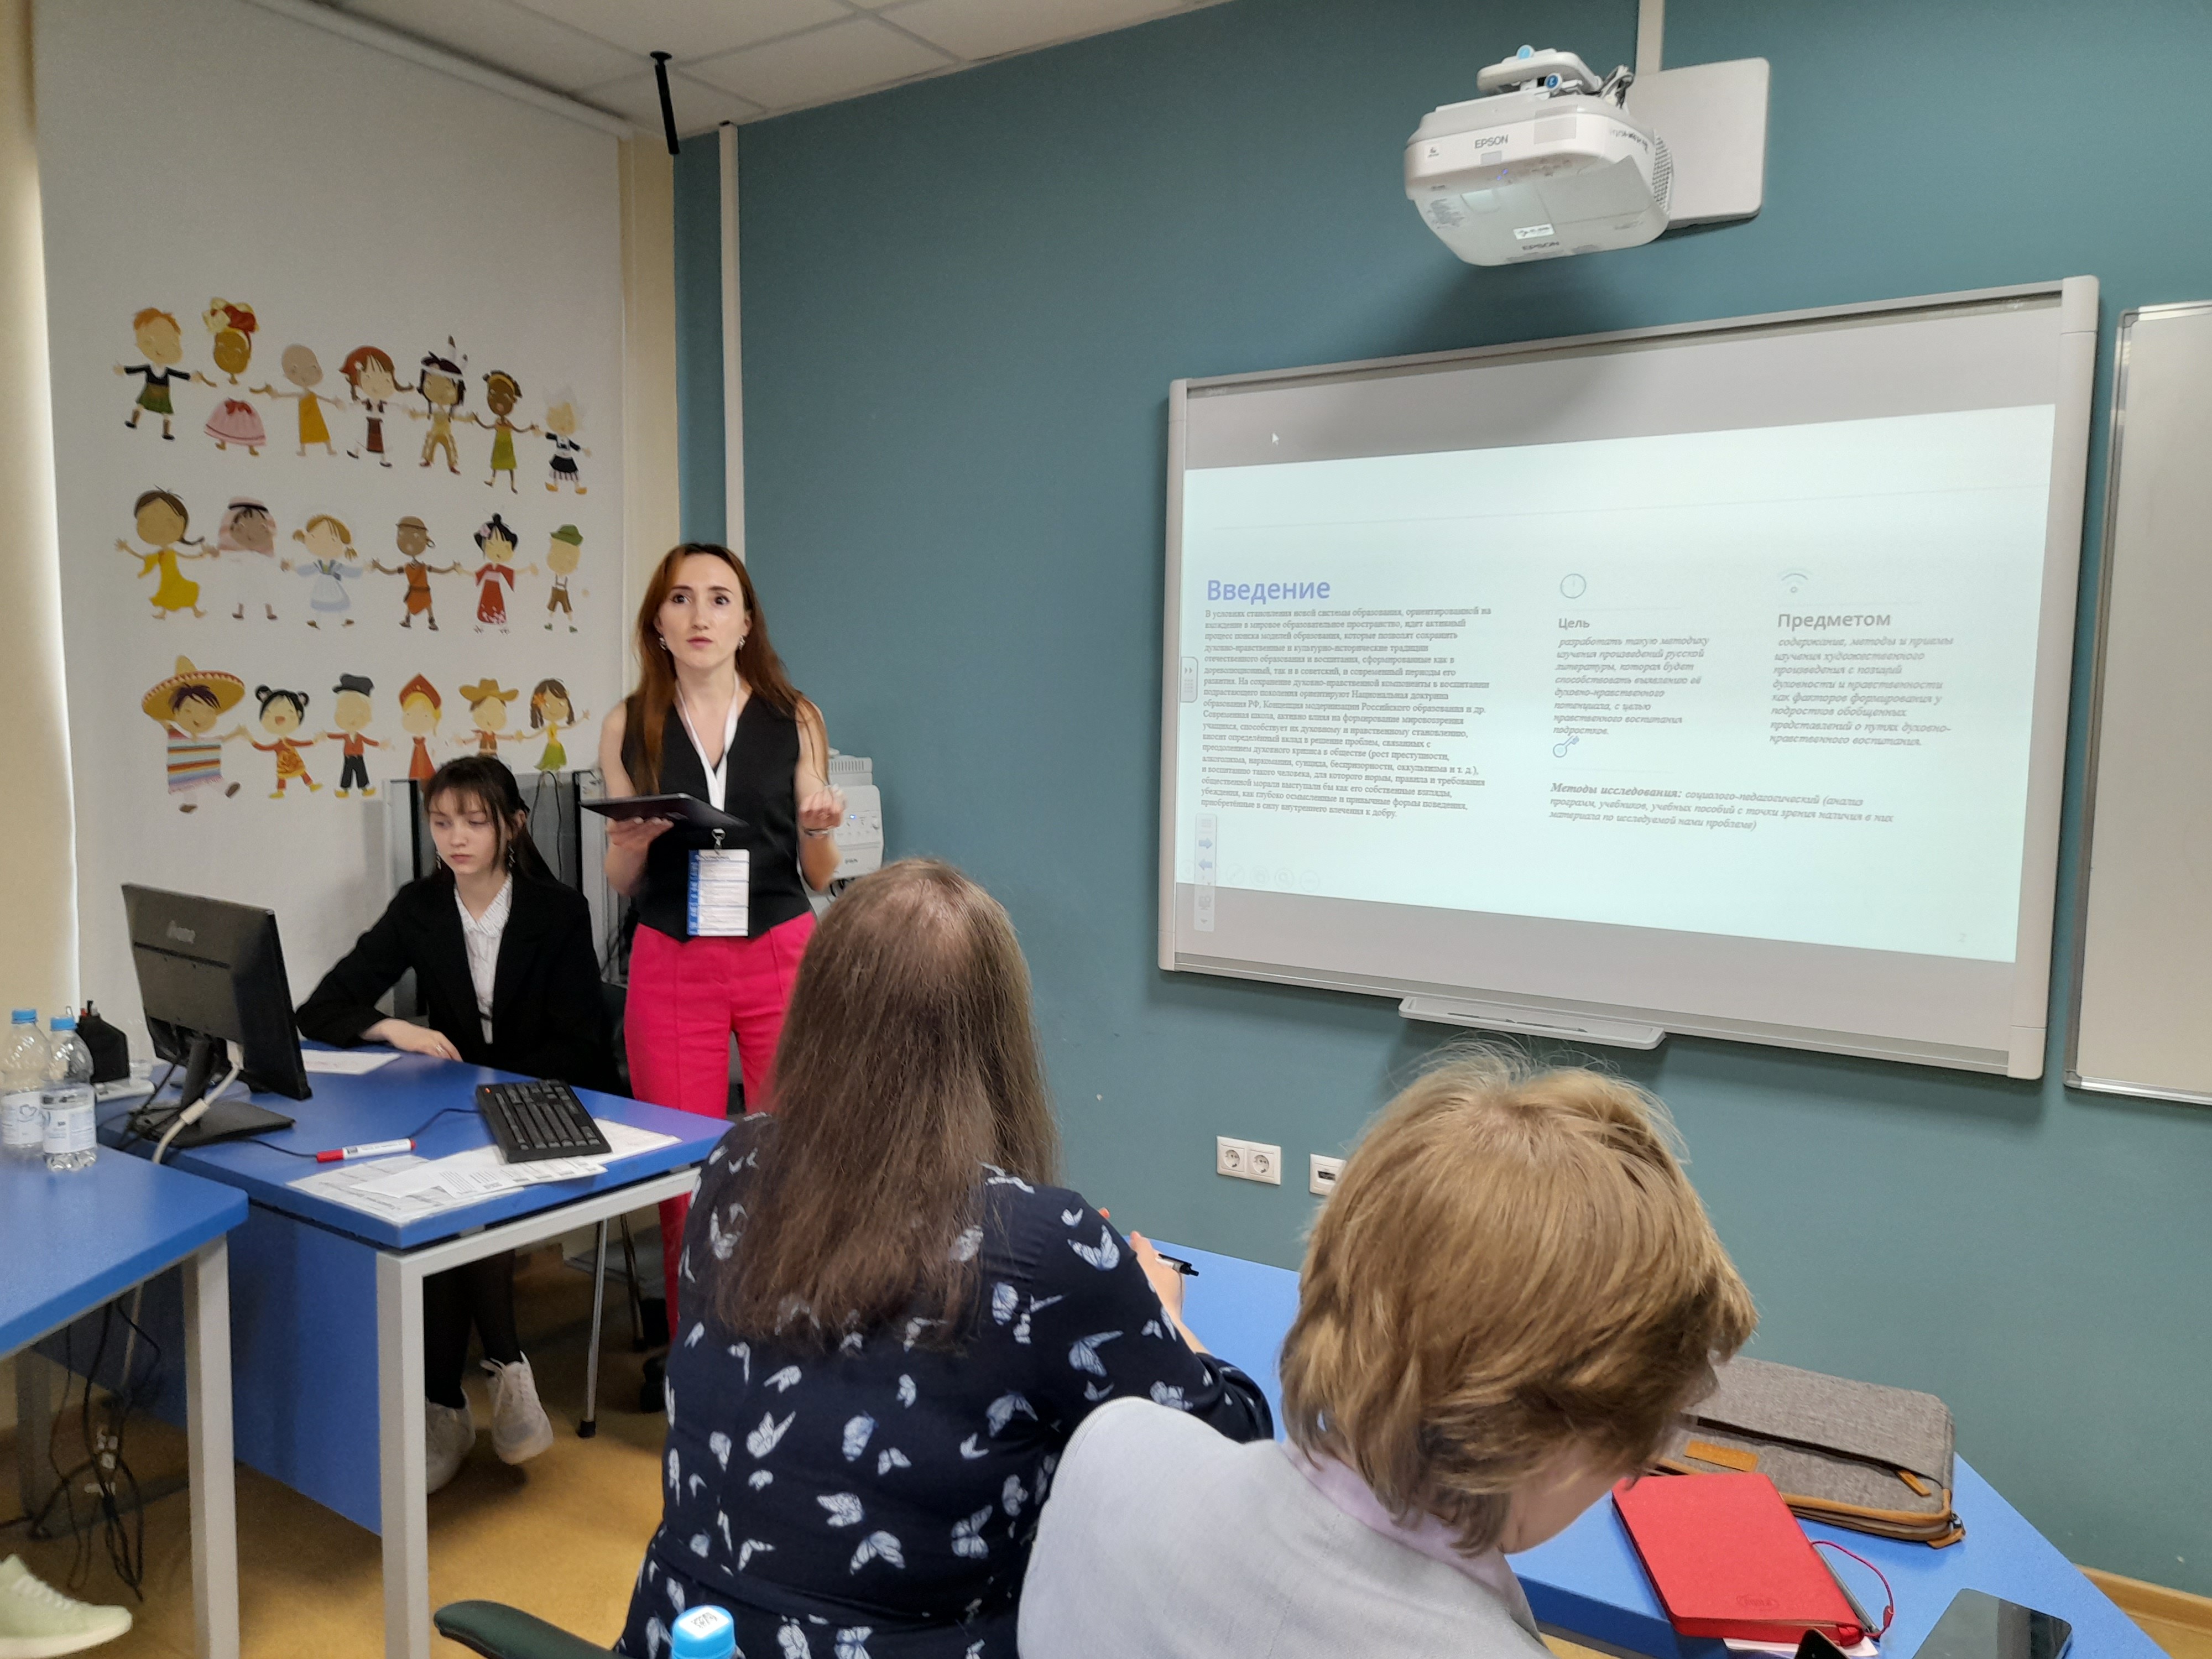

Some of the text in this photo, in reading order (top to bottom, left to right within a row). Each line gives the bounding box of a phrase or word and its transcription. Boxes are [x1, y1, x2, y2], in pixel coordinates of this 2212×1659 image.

[1474, 134, 1509, 149] EPSON
[1207, 580, 1331, 605] Введение
[1558, 618, 1590, 630] Цель
[1777, 613, 1891, 632] Предметом
[1551, 781, 1598, 795] Методы
[1600, 785, 1682, 799] исследования:
